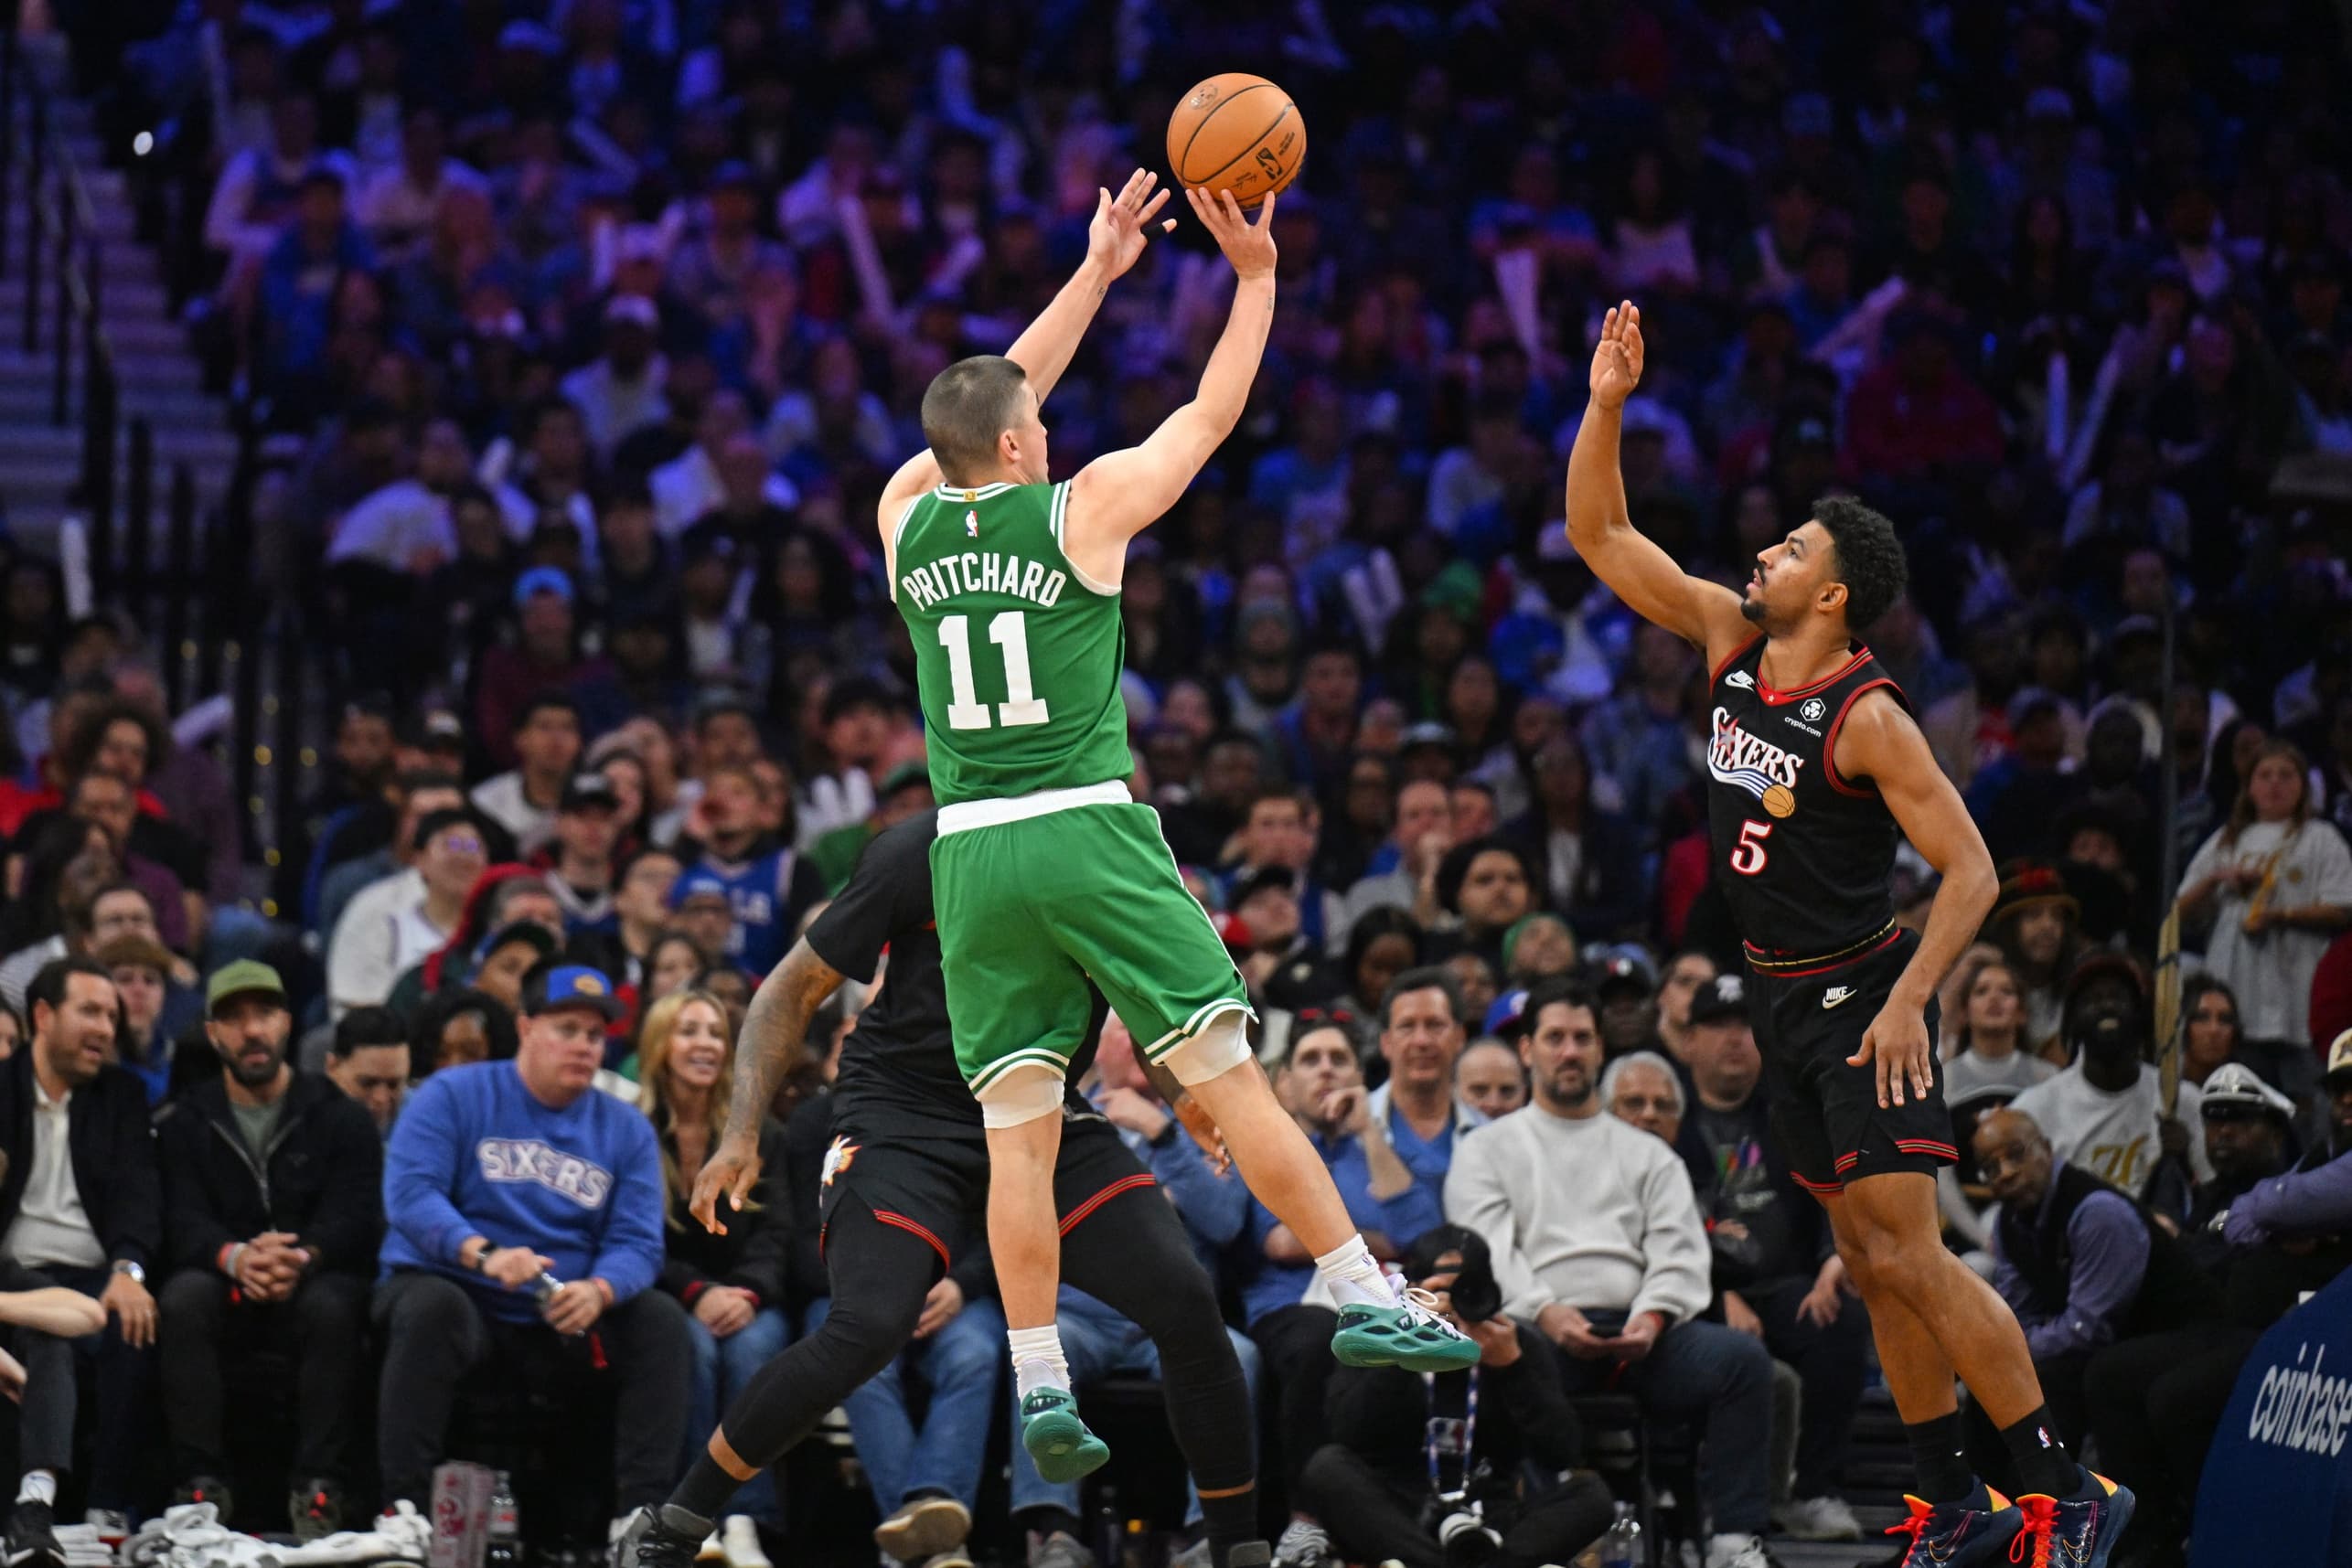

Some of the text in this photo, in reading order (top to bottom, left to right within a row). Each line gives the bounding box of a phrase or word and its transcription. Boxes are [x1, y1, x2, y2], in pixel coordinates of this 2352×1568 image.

[901, 552, 1066, 612] PRITCHARD
[937, 611, 1050, 729] 11
[1784, 716, 1822, 738] crypto.com
[1730, 819, 1772, 875] 5
[1825, 986, 1848, 1001] NIKE
[476, 1137, 615, 1211] SIXERS
[2249, 1341, 2352, 1457] coinbase
